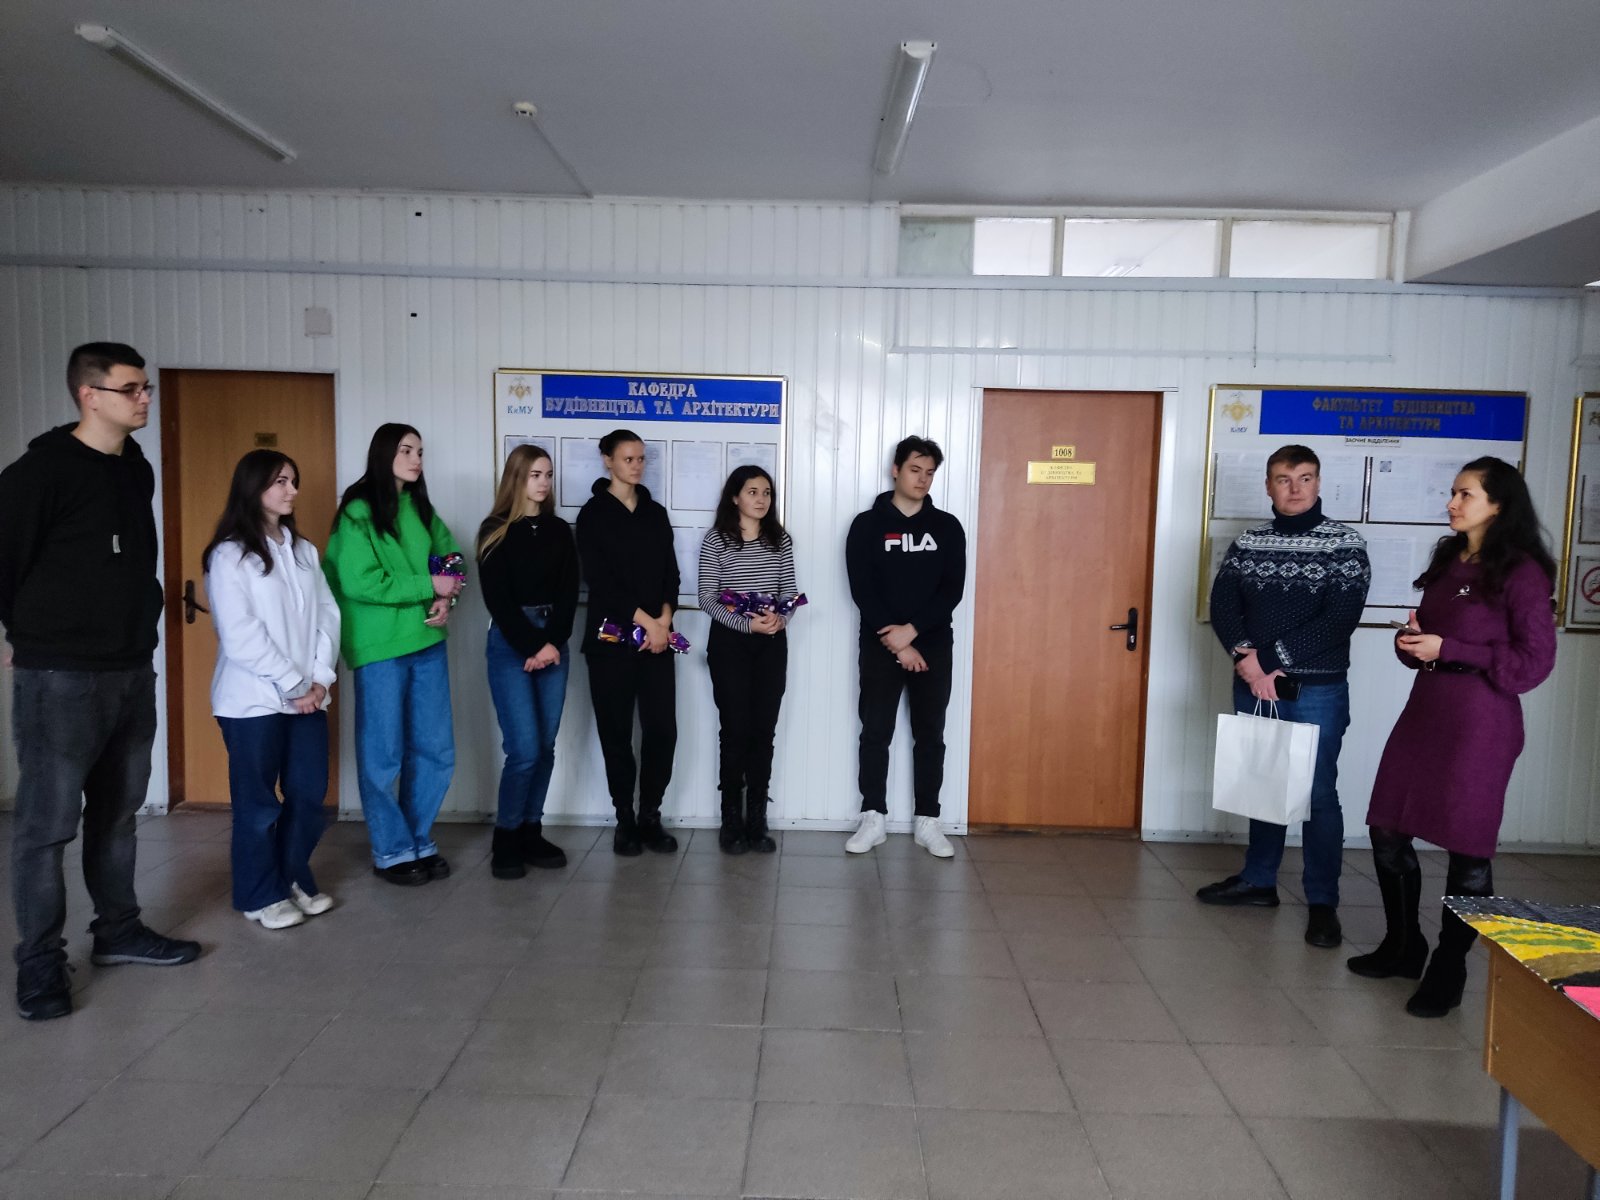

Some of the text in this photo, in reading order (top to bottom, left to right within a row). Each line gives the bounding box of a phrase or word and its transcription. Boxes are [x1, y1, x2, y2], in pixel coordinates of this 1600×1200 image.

[628, 382, 698, 400] КАФЕДРА
[545, 397, 779, 418] БУДІВНИЦТВА ТА АРХІТЕКТУРИ
[1312, 397, 1383, 413] ФАКУЛЬТЕТ
[1339, 416, 1354, 430] ТА
[1055, 448, 1073, 457] 1008
[884, 533, 938, 553] FILA
